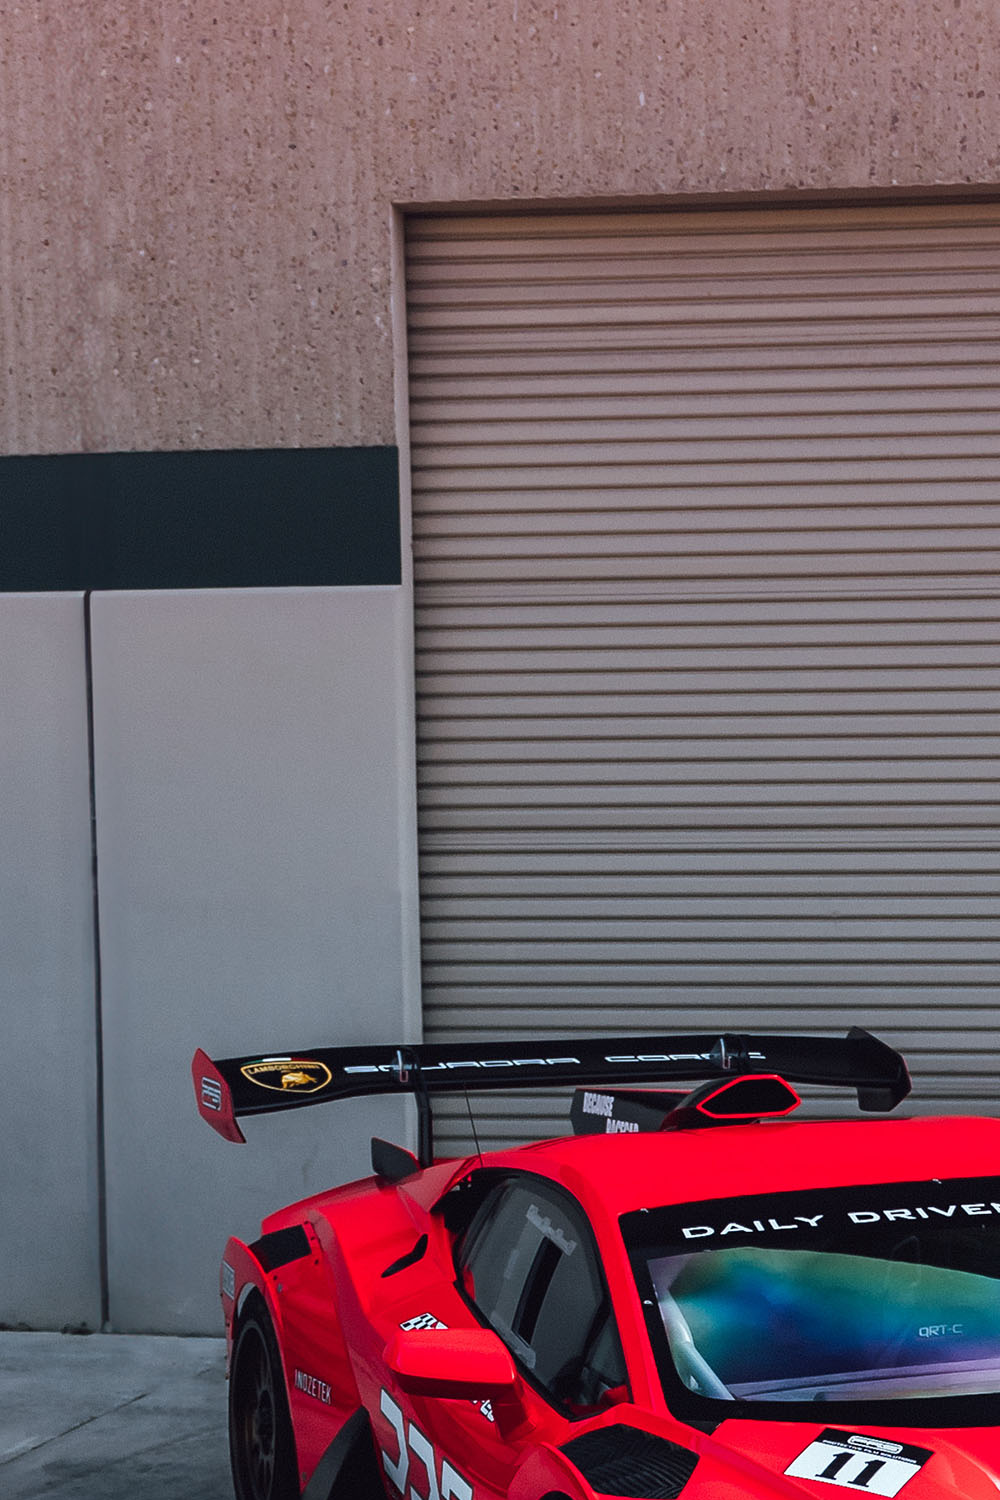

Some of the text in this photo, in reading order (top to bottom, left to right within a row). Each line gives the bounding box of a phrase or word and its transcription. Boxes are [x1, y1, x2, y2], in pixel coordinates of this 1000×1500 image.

[681, 1215, 823, 1239] DAILY
[919, 1324, 963, 1338] QRT-C
[815, 1451, 887, 1488] 11
